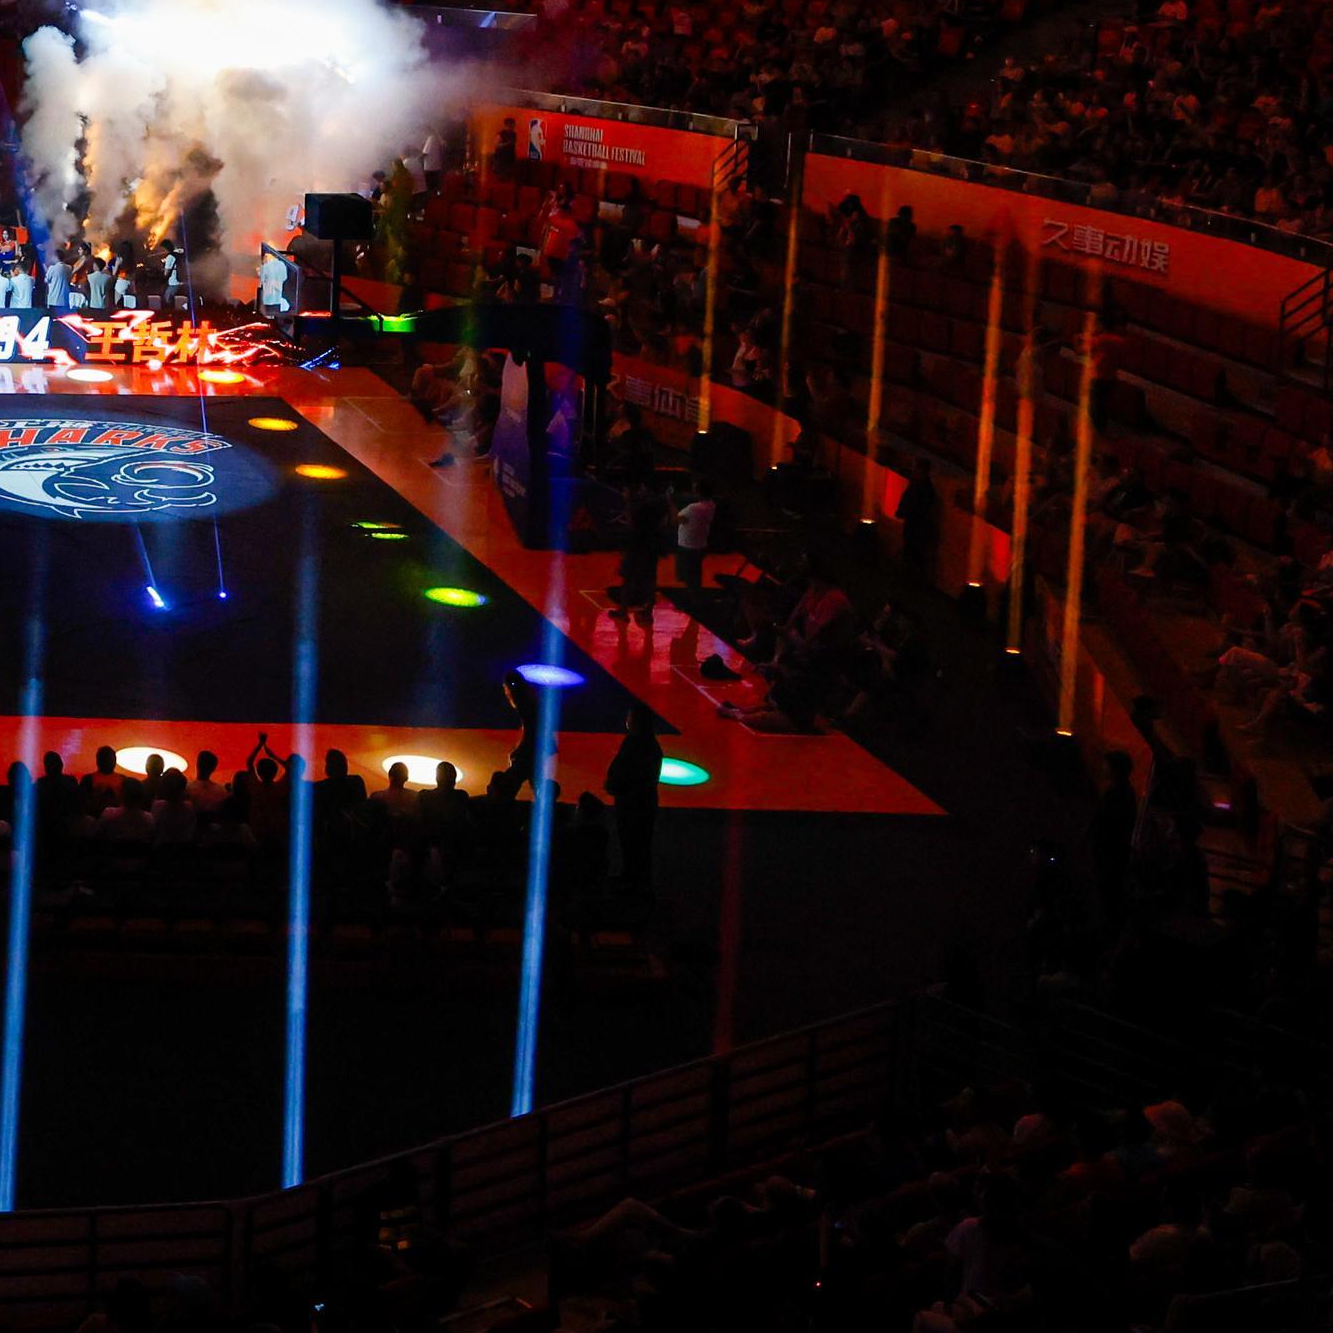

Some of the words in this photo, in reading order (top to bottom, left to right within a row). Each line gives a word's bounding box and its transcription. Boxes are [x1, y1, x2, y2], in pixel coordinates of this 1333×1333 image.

[564, 124, 604, 144] SHANGHAI
[564, 139, 610, 160] BASKETBALL
[611, 146, 646, 167] FESTIVAL
[85, 321, 220, 365] 王哲林
